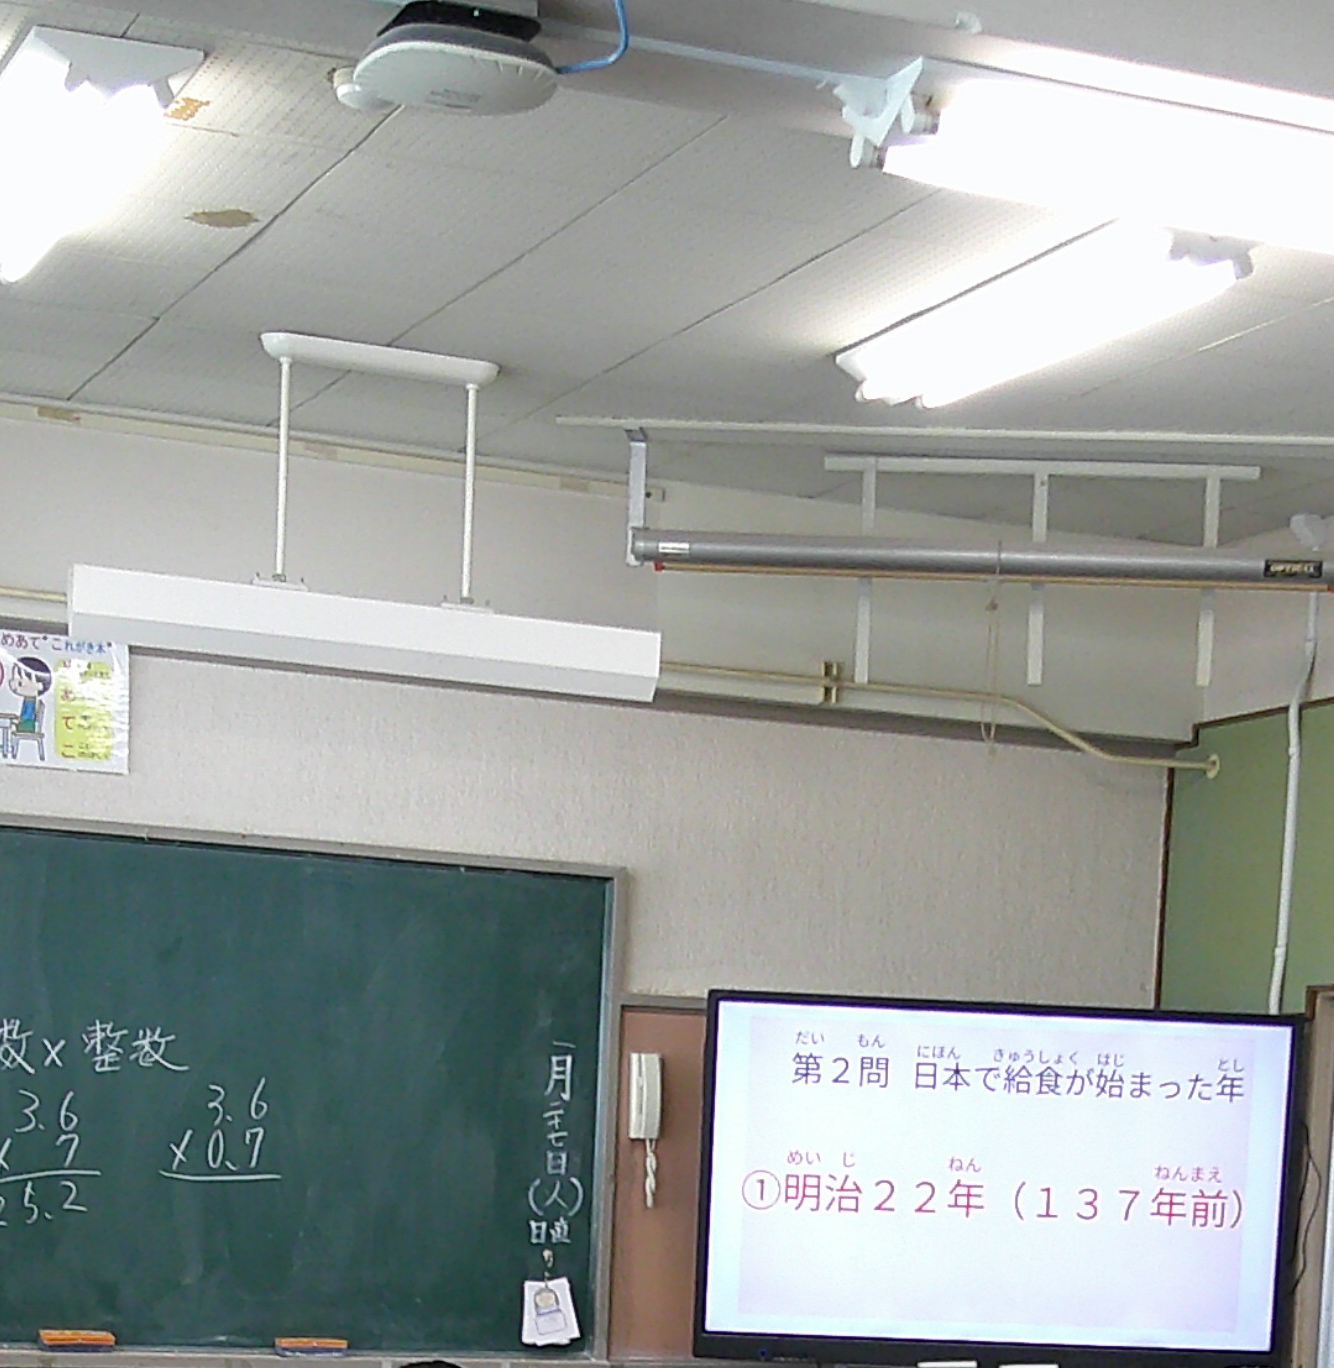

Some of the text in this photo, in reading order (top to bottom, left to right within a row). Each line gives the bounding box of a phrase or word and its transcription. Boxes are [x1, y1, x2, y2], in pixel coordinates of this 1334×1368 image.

[795, 1031, 825, 1045] だい
[858, 1033, 885, 1048] もん
[917, 1045, 961, 1060] にほん
[1097, 1053, 1125, 1068] はじ
[1217, 1059, 1245, 1072] とし
[207, 1076, 269, 1127] 3.6
[915, 1062, 1245, 1103] 日本で給食が始まった年
[15, 1089, 78, 1133] 3.6
[948, 1156, 982, 1172] ねん
[1154, 1165, 1223, 1183] ねんまえ
